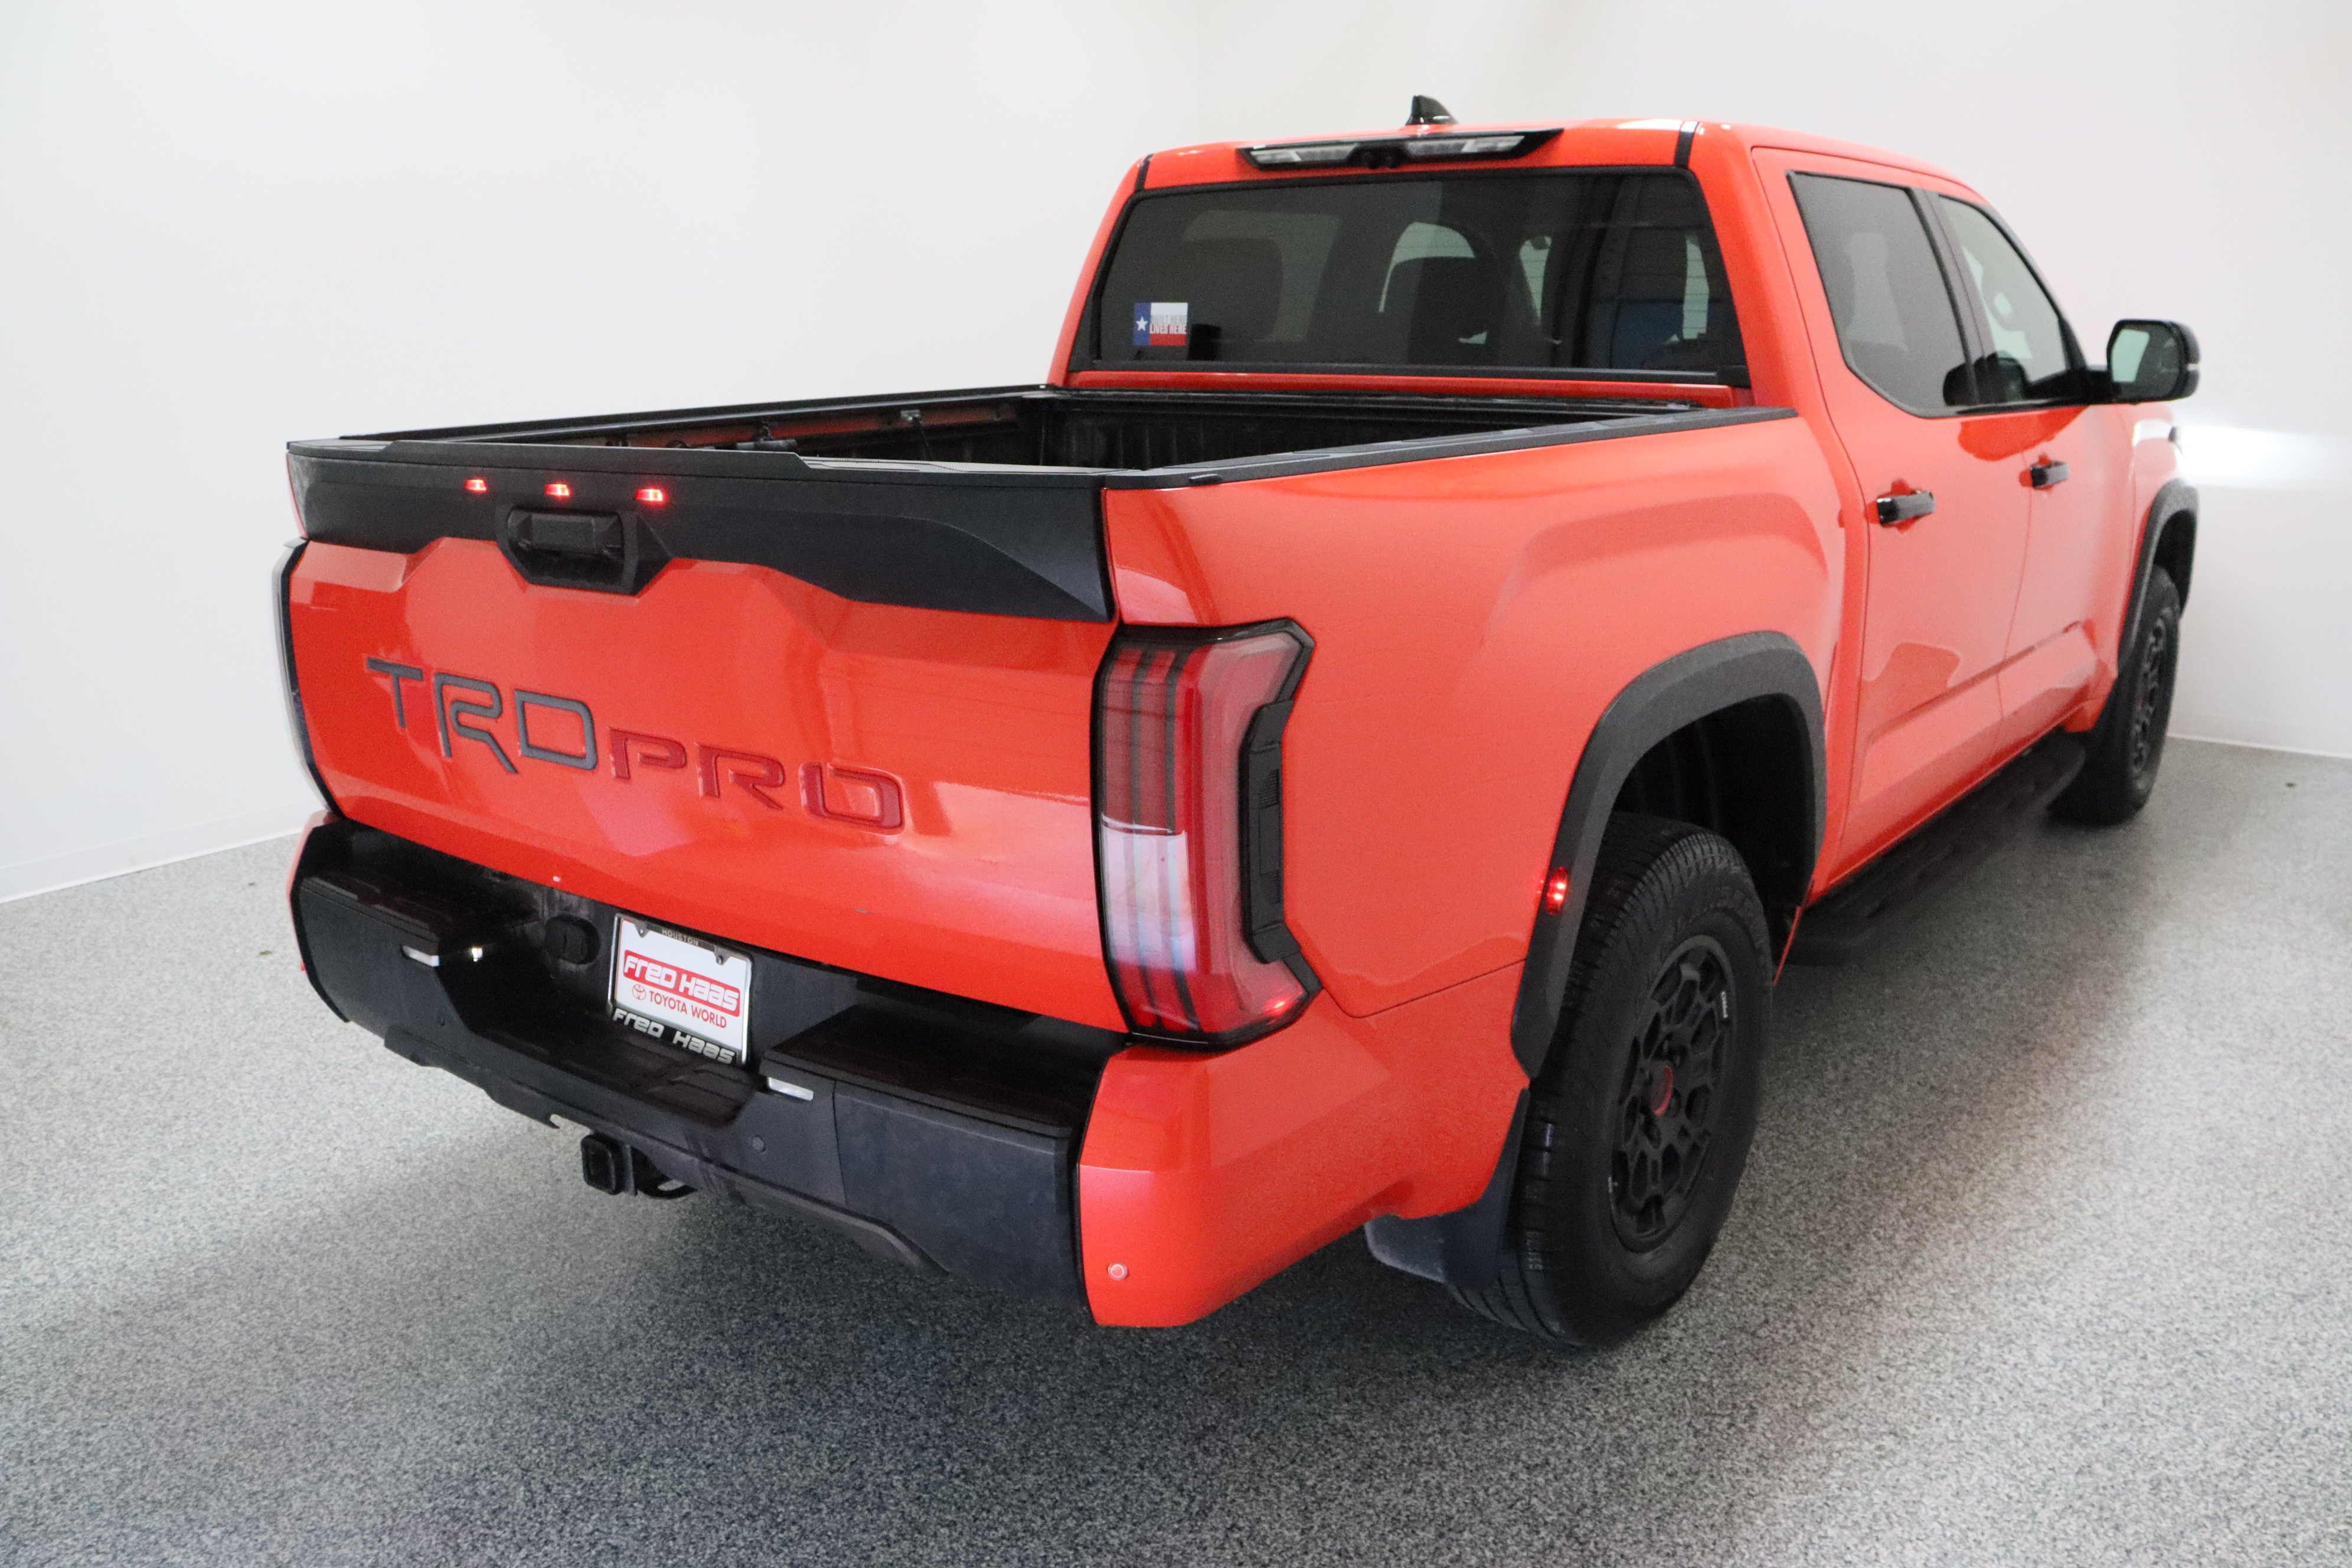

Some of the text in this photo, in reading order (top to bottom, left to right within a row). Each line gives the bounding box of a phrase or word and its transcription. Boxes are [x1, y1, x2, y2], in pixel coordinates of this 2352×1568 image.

[1150, 324, 1187, 334] LIVES HERE
[365, 656, 906, 831] TRD PRO
[662, 929, 699, 946] HOUSTON
[649, 990, 727, 1028] TOYOTA WORLD
